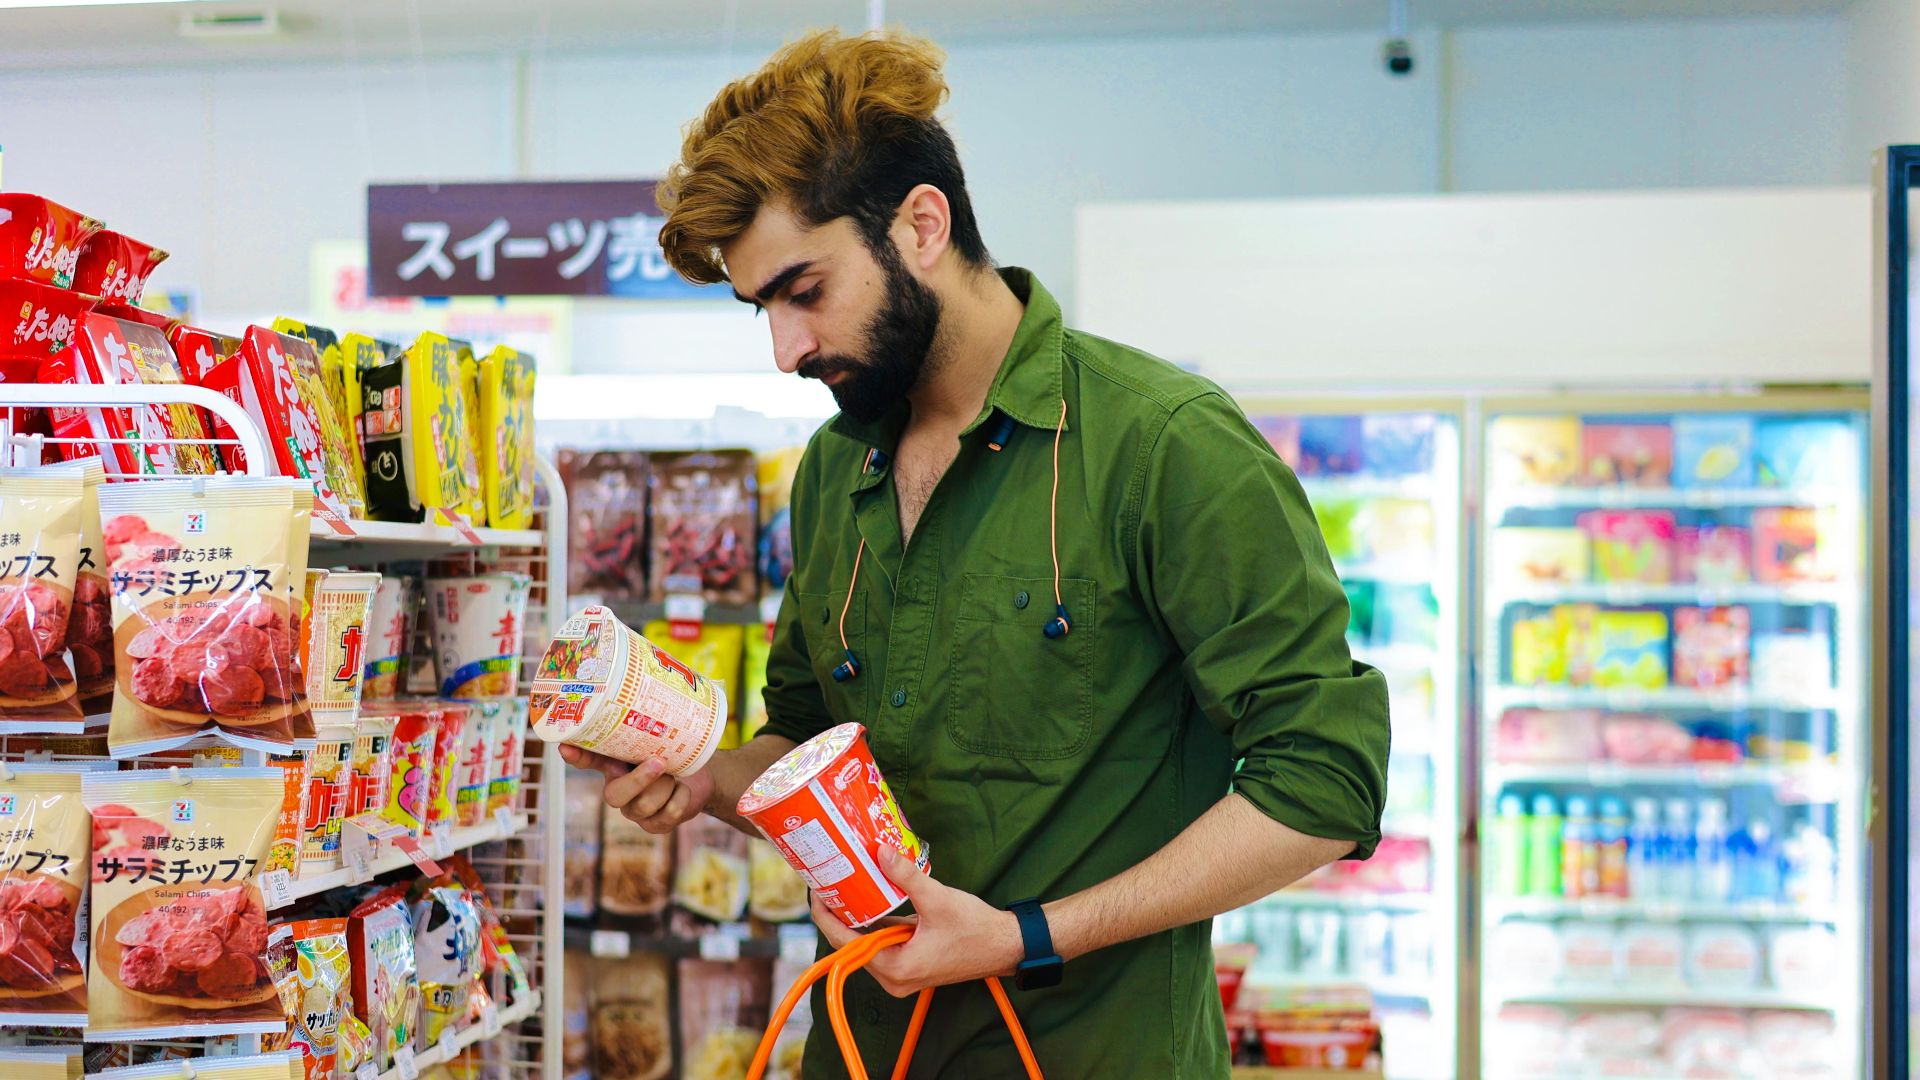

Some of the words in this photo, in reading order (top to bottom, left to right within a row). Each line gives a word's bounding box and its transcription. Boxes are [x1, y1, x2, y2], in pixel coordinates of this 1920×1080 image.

[152, 547, 233, 563] 濃厚なうま味
[111, 565, 274, 597] サラミチップス
[163, 601, 193, 610] Salami
[194, 601, 218, 610] Chips
[142, 835, 225, 851] 濃厚なうま味
[154, 890, 184, 898] Salami
[186, 890, 211, 899] Chips
